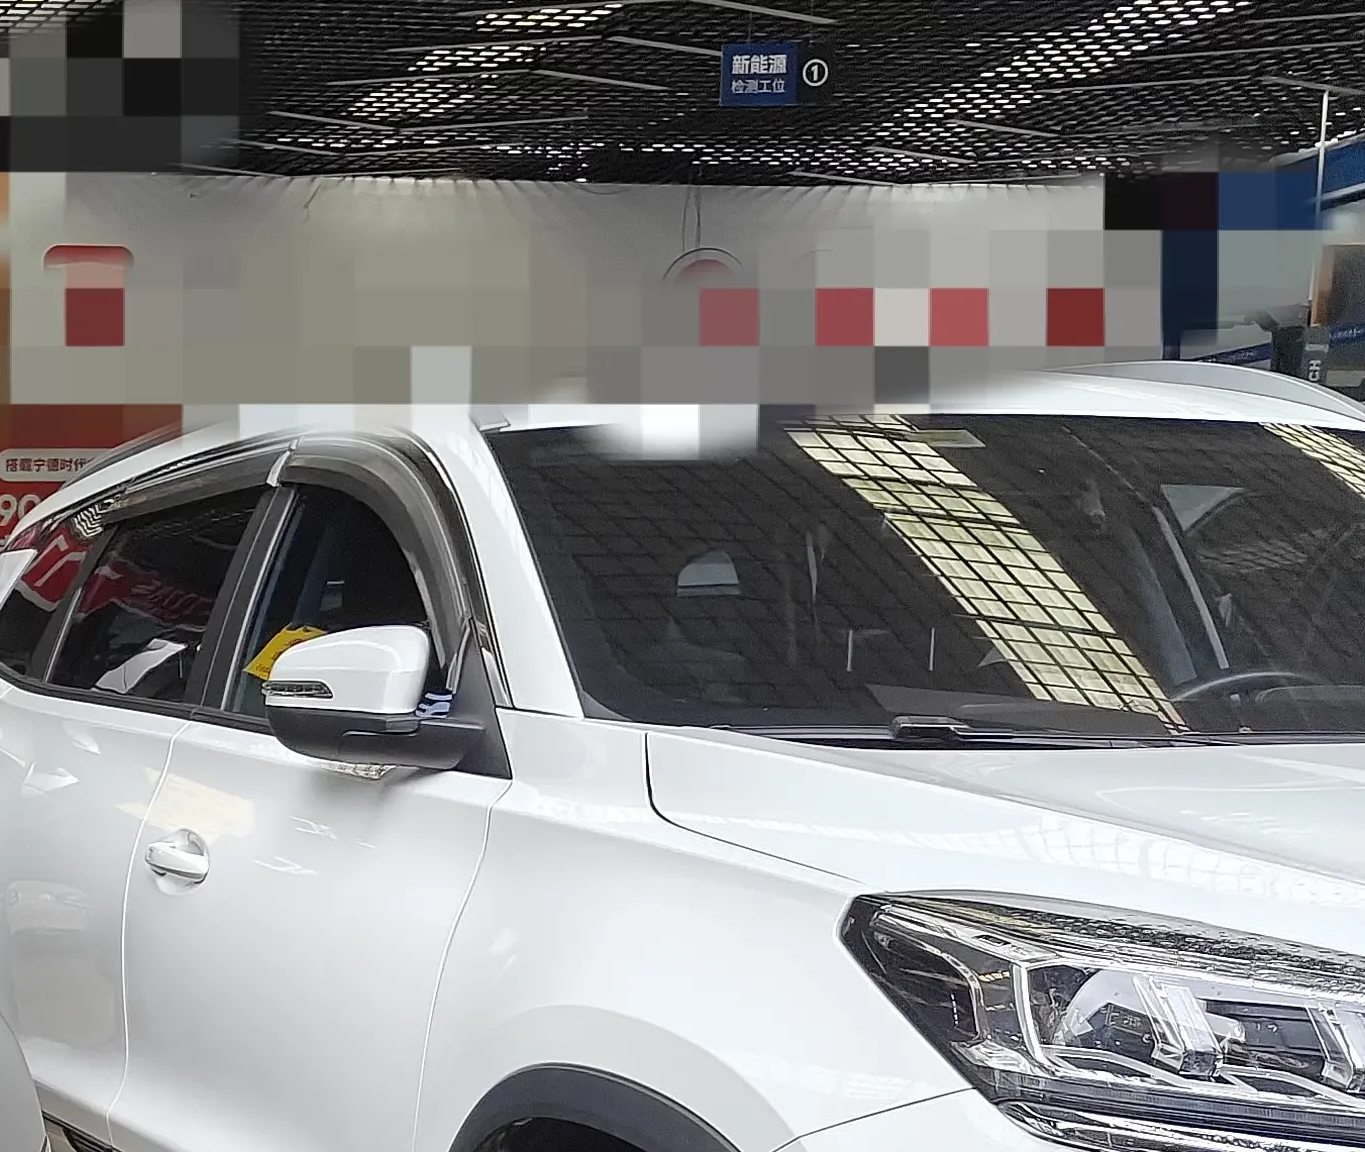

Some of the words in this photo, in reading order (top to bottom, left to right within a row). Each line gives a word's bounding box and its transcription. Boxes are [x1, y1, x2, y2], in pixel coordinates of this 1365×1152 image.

[732, 54, 787, 75] 新能源
[732, 79, 785, 93] 检测工位
